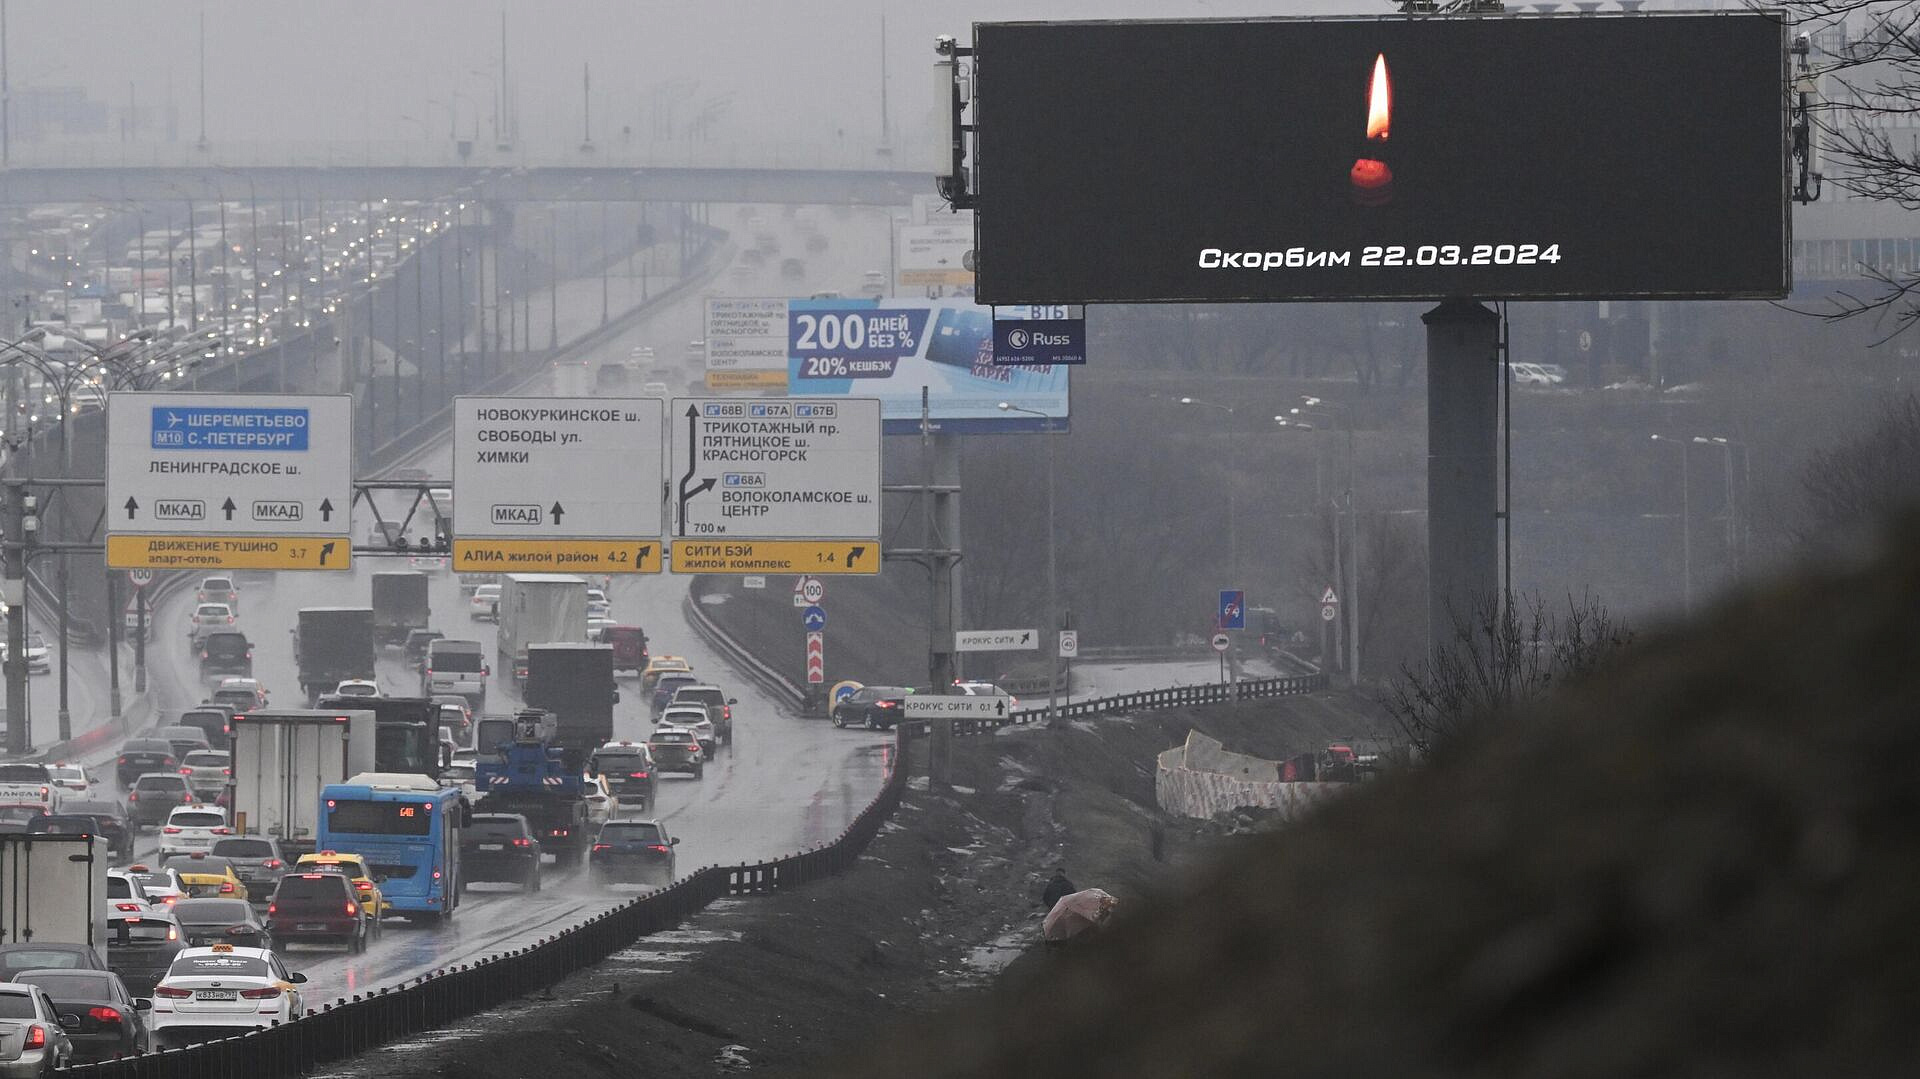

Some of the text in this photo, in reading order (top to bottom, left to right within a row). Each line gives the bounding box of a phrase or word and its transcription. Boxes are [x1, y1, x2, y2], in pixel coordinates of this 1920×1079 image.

[1199, 244, 1562, 271] Скорбим 22.03.2024
[868, 314, 909, 334] ДНЕЙ
[796, 314, 865, 350] 200
[868, 331, 914, 348] БЕЗ %
[1033, 332, 1071, 346] Russ
[808, 357, 892, 376] 20% КЕШБЭК
[476, 409, 641, 422] НОВОКУРКИНСКОЕ ш.
[721, 406, 743, 416] 68B
[767, 406, 790, 416] 67A
[812, 406, 834, 416] 67B
[188, 414, 306, 428] ШЕРЕМЕТЬЕВО
[703, 420, 841, 436] ТРИКОТАЖНЫЙ пр.
[188, 432, 295, 446] С.-ПЕТЕРБУРГ
[477, 430, 583, 445] СВОБОДЫ ул.
[703, 436, 811, 448] ПЯТНИЦКОЕ ш.
[476, 451, 529, 464] ХИМКИ
[703, 449, 807, 461] КРАСНОГОРСК
[149, 461, 301, 476] ЛЕНИНГРАДСКОЕ ш.
[741, 475, 763, 485] 68A
[722, 491, 873, 504] ВОЛОКОЛАМСКОЕ ш.
[159, 503, 202, 517] МКАД
[256, 504, 300, 518] МКАД
[495, 509, 539, 522] МКАД
[722, 505, 769, 518] ЦЕНТР
[694, 523, 726, 533] 700 м
[148, 541, 278, 553] ДВИЖЕНИЕ ТУШИНО
[685, 543, 753, 556] СИТИ БЭЙ
[148, 555, 222, 565] апарт-отель
[289, 549, 307, 559] 3.7
[463, 549, 628, 564] АЛИА жилой район 4.2
[817, 552, 835, 563] 1.4
[685, 557, 791, 569] жилой комплекс
[133, 568, 152, 579] 100
[806, 585, 822, 596] 100
[995, 637, 1015, 645] СИТИ
[906, 702, 991, 711] КРОКУС СИТИ 0.1
